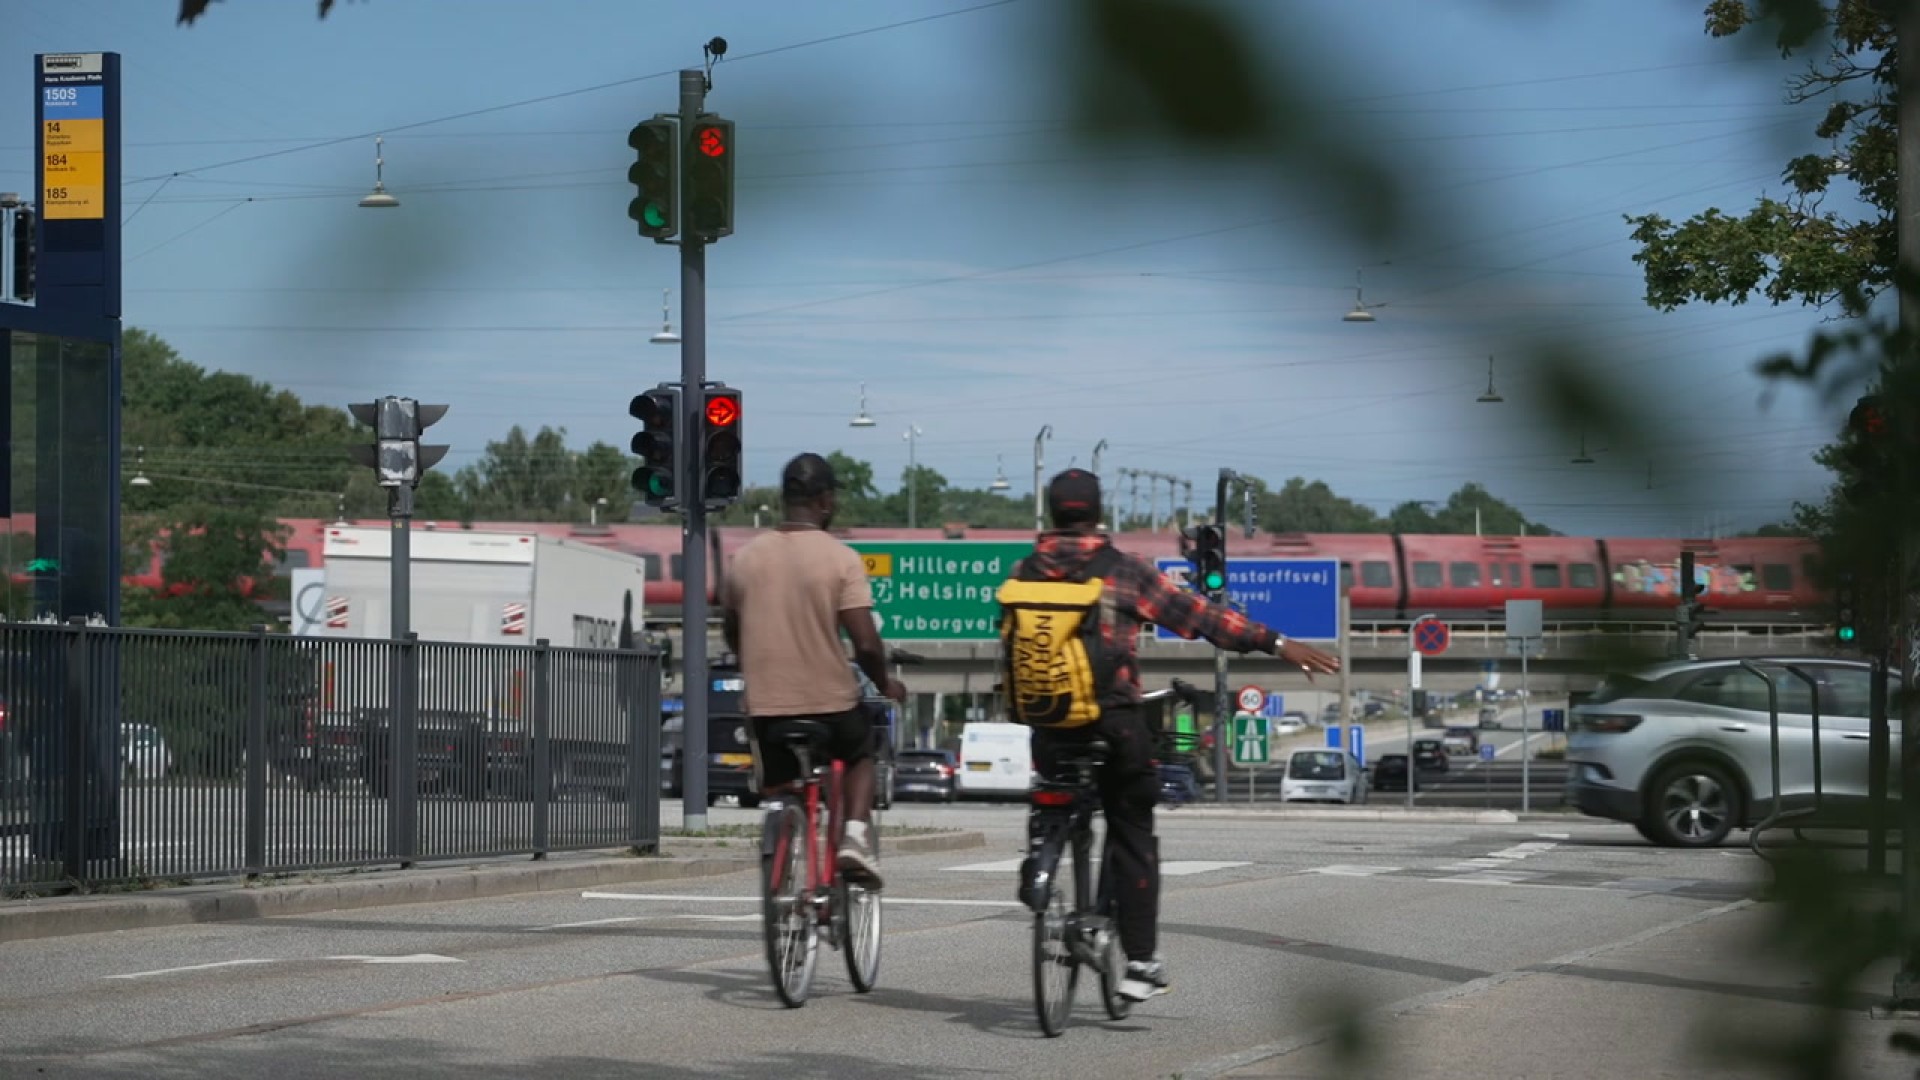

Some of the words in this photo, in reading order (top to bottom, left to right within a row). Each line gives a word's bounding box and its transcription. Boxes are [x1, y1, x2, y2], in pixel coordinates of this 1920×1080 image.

[45, 88, 77, 100] 150S
[47, 122, 61, 133] 14
[46, 154, 67, 166] 184
[46, 188, 68, 199] 185
[900, 556, 1001, 574] Hillerød
[1227, 569, 1328, 585] nstorffsvej
[900, 582, 996, 603] Helsing
[891, 615, 997, 634] Tuborgvej
